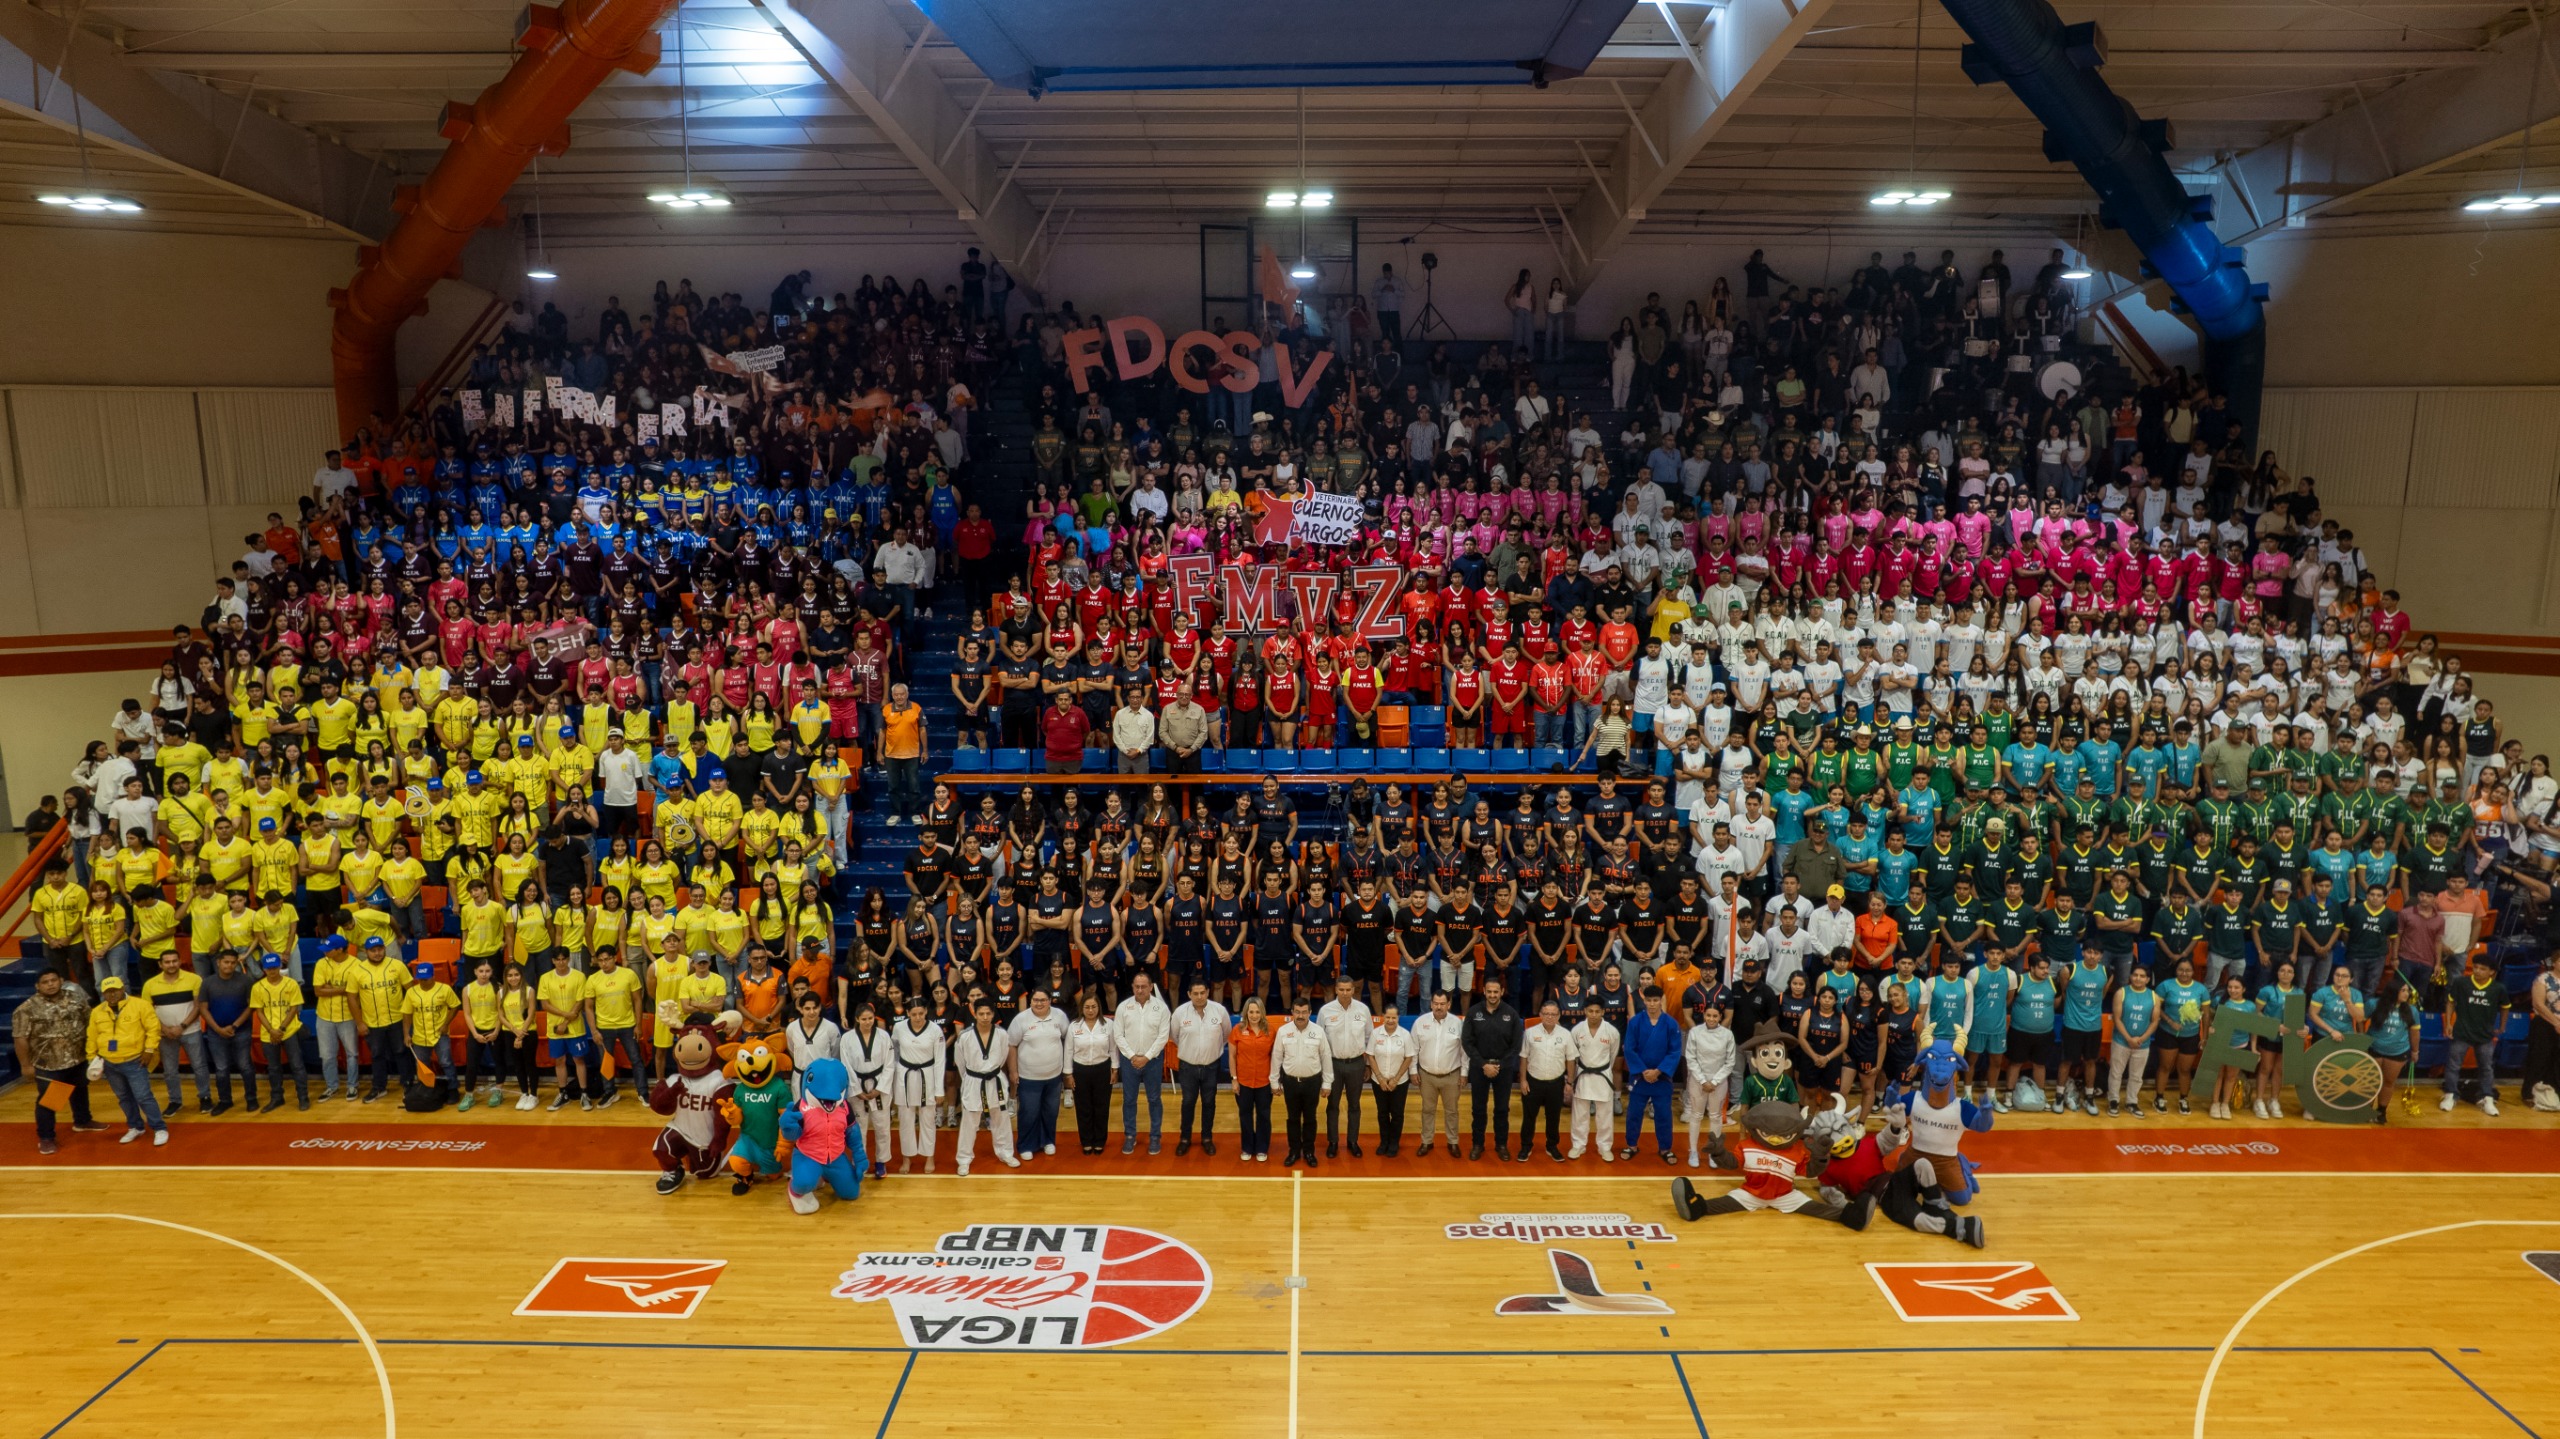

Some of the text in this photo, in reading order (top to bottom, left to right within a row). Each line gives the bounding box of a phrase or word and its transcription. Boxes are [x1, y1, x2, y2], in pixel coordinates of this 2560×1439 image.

[1063, 316, 1334, 408] FDCSV
[1315, 494, 1358, 506] VETERINARIA
[1293, 500, 1363, 524] CUERNOS
[1290, 521, 1352, 543] LARGOS
[1168, 552, 1406, 640] FMVZ
[2363, 924, 2381, 932] F.I.C.
[2469, 998, 2489, 1006] F.I.C.
[1860, 1062, 1871, 1070] 10
[745, 1093, 771, 1103] FCAV
[1937, 1119, 1959, 1131] MANTE
[289, 1137, 486, 1151] #EsteEsMiJuego
[1449, 1222, 1672, 1241] Tamaulipas
[942, 1228, 1098, 1252] LNBP
[862, 1255, 1031, 1270] caliente.mx
[909, 1315, 1079, 1344] LIGA
